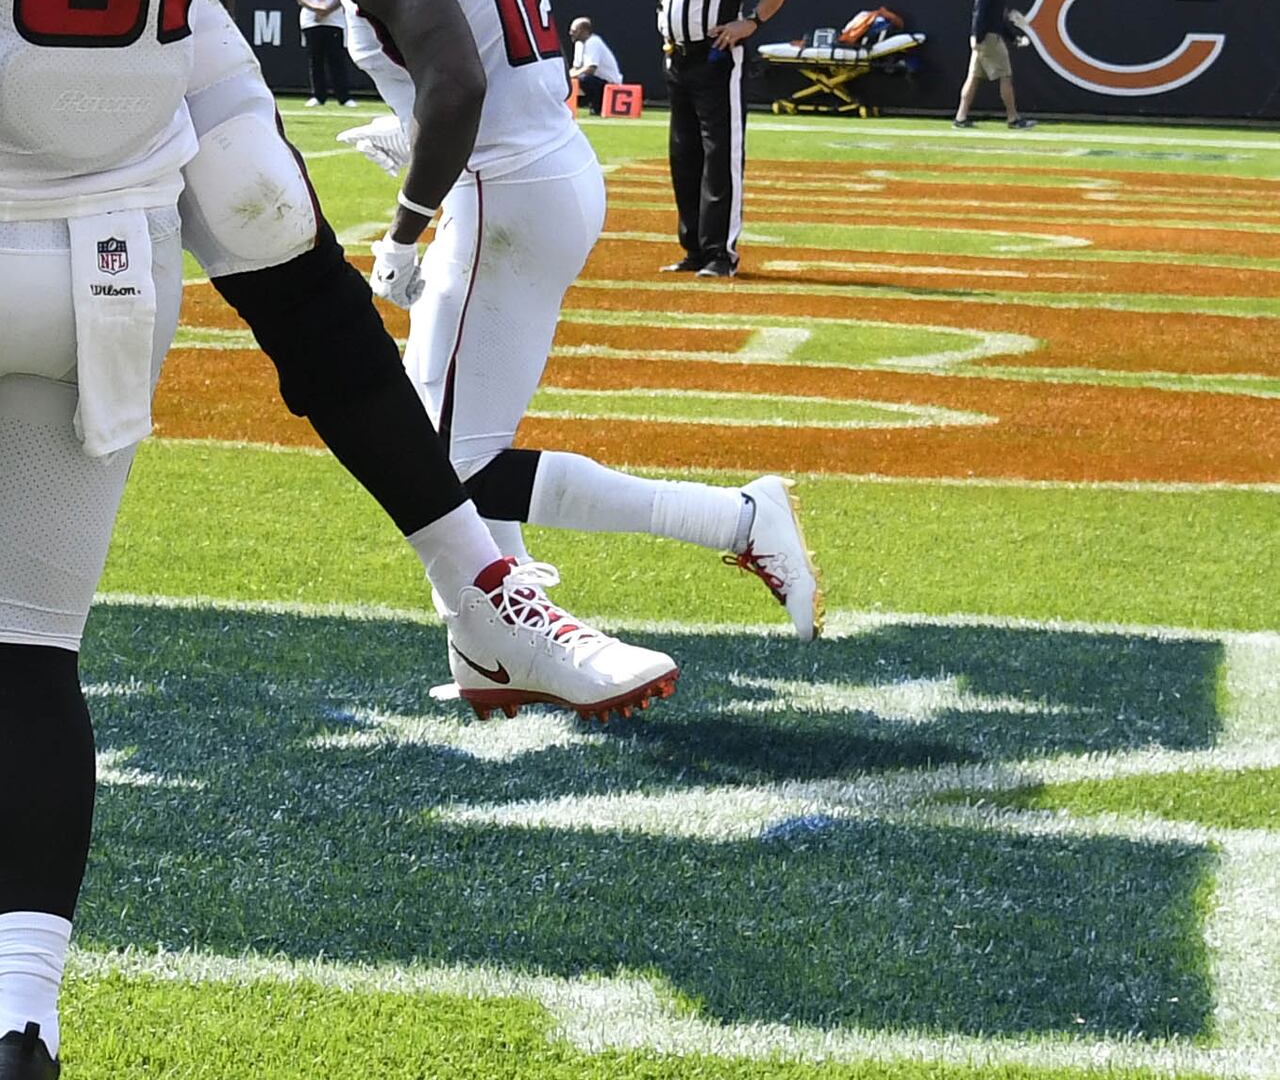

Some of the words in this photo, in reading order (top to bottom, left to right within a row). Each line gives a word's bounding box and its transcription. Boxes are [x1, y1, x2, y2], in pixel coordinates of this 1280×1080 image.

[254, 10, 281, 46] M
[611, 89, 633, 115] G
[100, 253, 126, 271] NFL
[90, 283, 135, 296] Wilson
